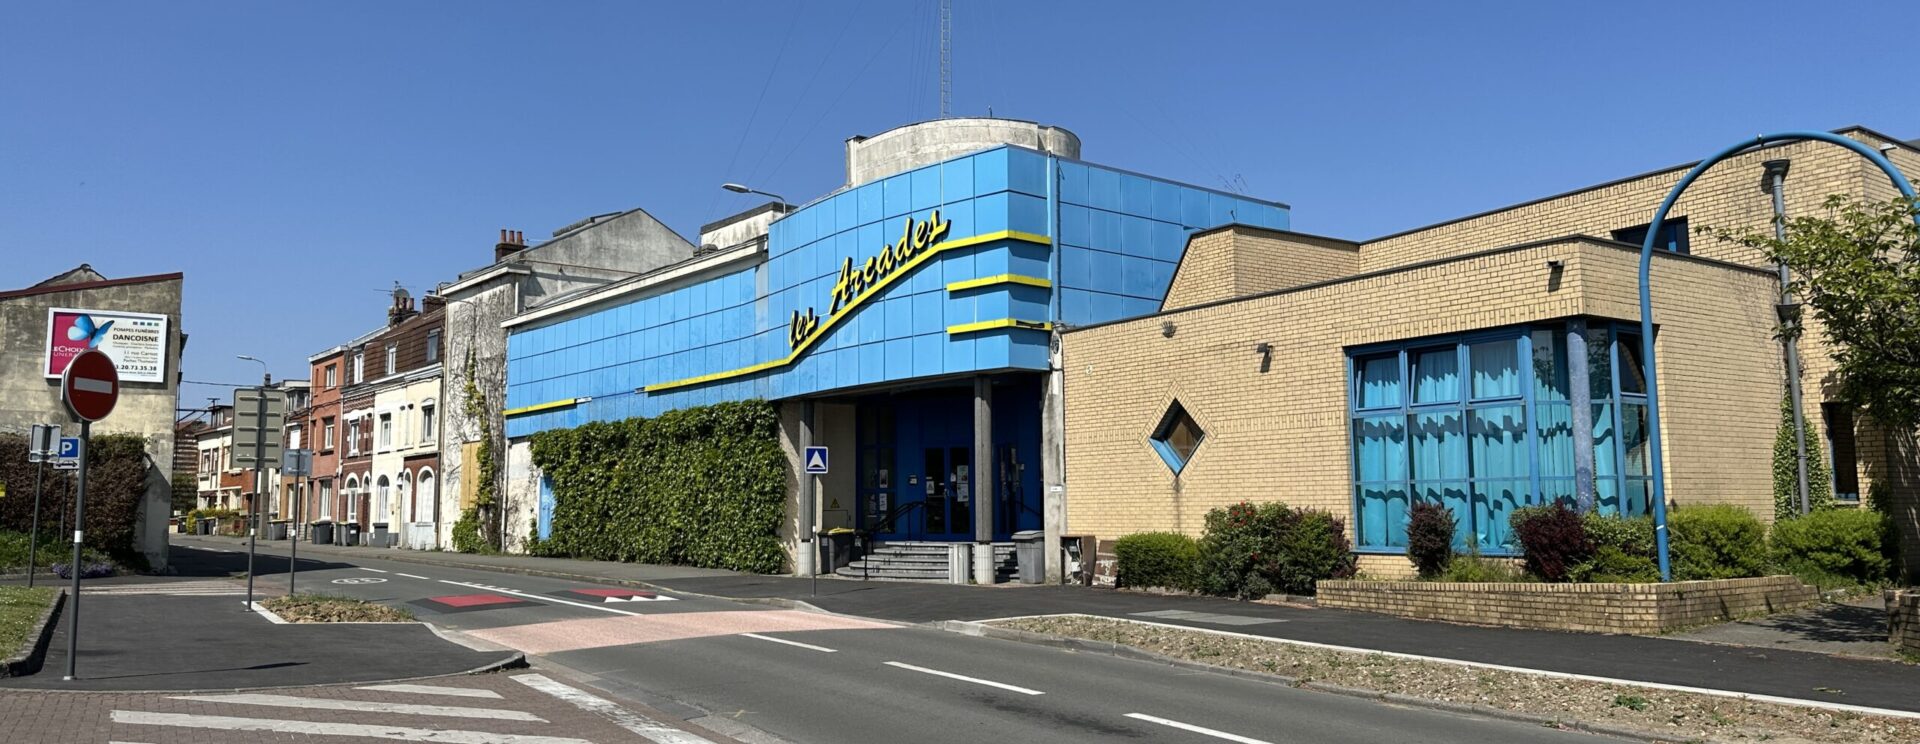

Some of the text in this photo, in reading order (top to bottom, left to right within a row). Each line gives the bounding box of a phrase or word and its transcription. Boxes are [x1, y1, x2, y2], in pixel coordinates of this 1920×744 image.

[789, 210, 952, 350] les Arcades
[112, 334, 159, 342] DANCOISNE
[62, 442, 72, 454] P
